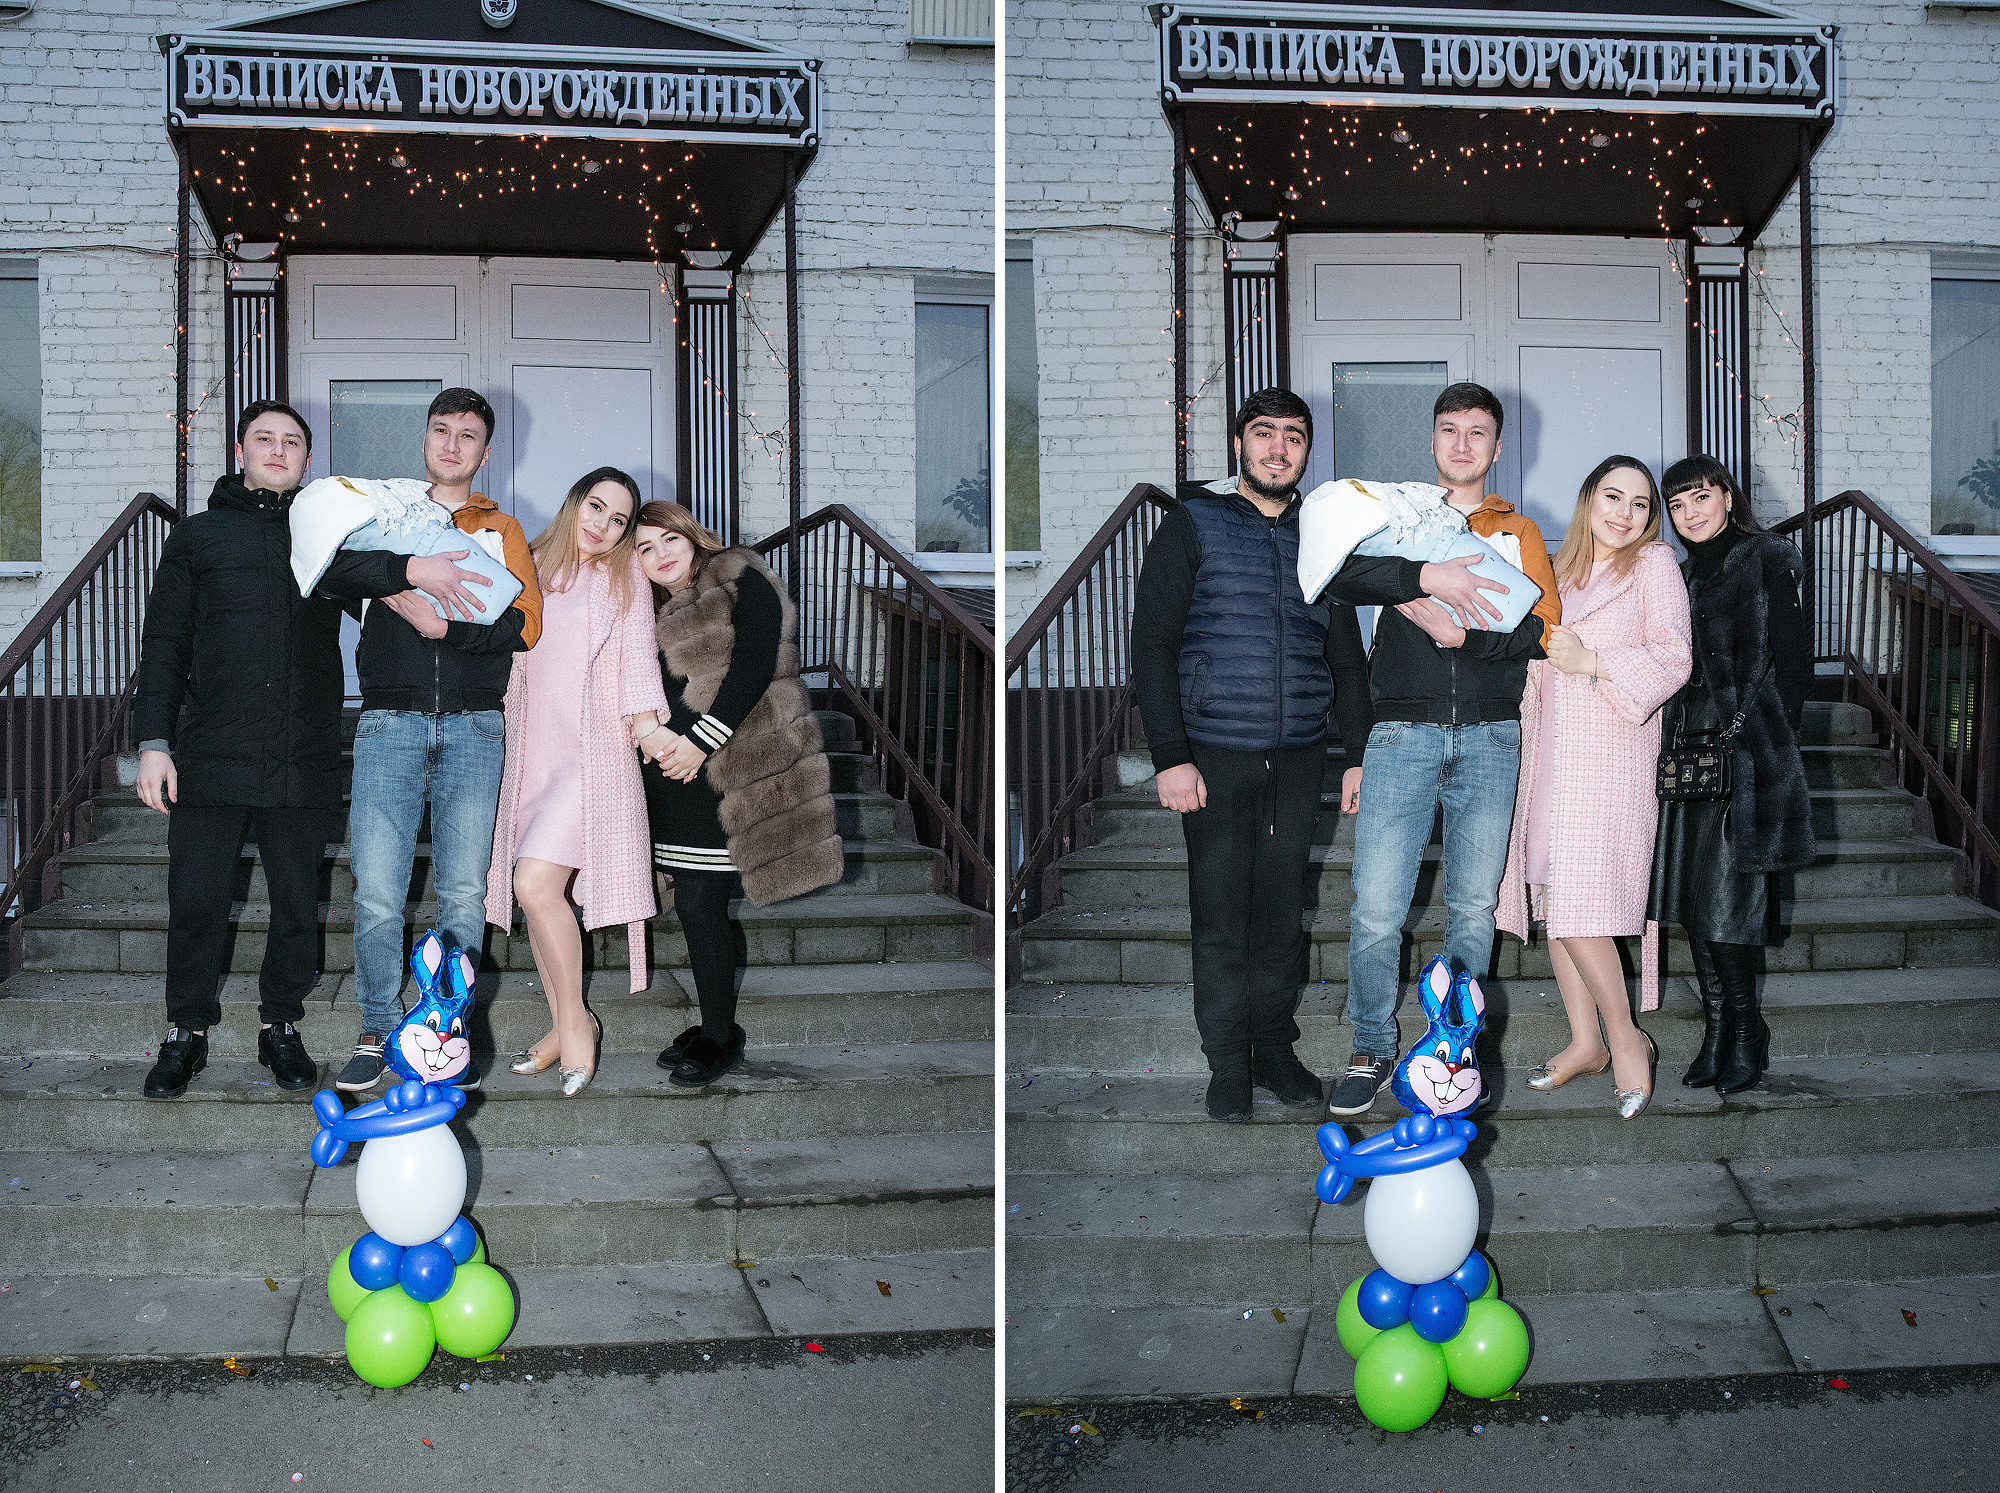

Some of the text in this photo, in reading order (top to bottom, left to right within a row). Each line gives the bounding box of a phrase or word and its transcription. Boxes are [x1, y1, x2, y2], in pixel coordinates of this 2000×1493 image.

[183, 54, 805, 126] ВЫПИСКА НОВОРОЖДЕННЫХ
[1177, 25, 1821, 97] ВЫПИСКА НОВОРОЖДЕННЫХ
